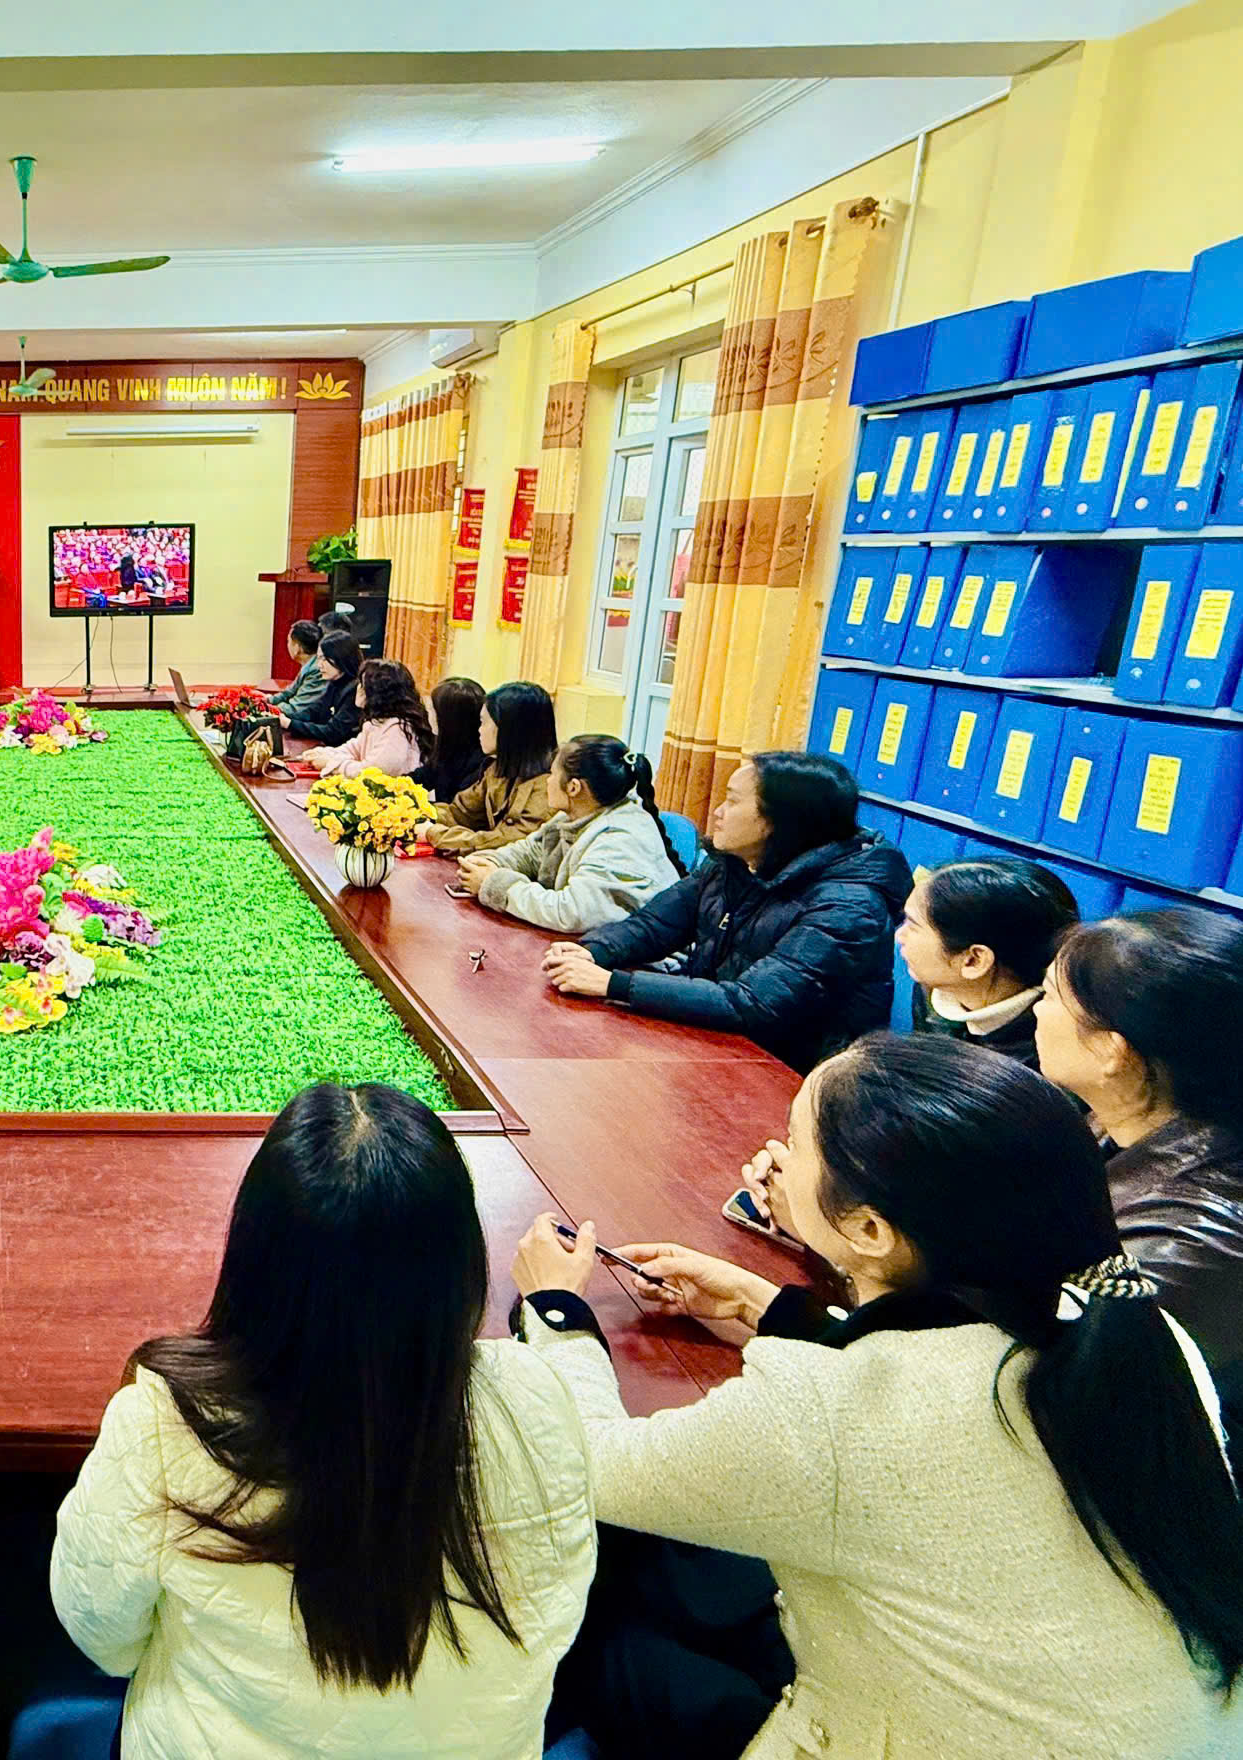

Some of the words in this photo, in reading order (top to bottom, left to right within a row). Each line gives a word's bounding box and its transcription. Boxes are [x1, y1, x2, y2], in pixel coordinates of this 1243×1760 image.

[44, 378, 110, 404] QUANG
[116, 378, 161, 401] VINH
[166, 373, 226, 401] MUÔN
[230, 371, 278, 401] NĂM
